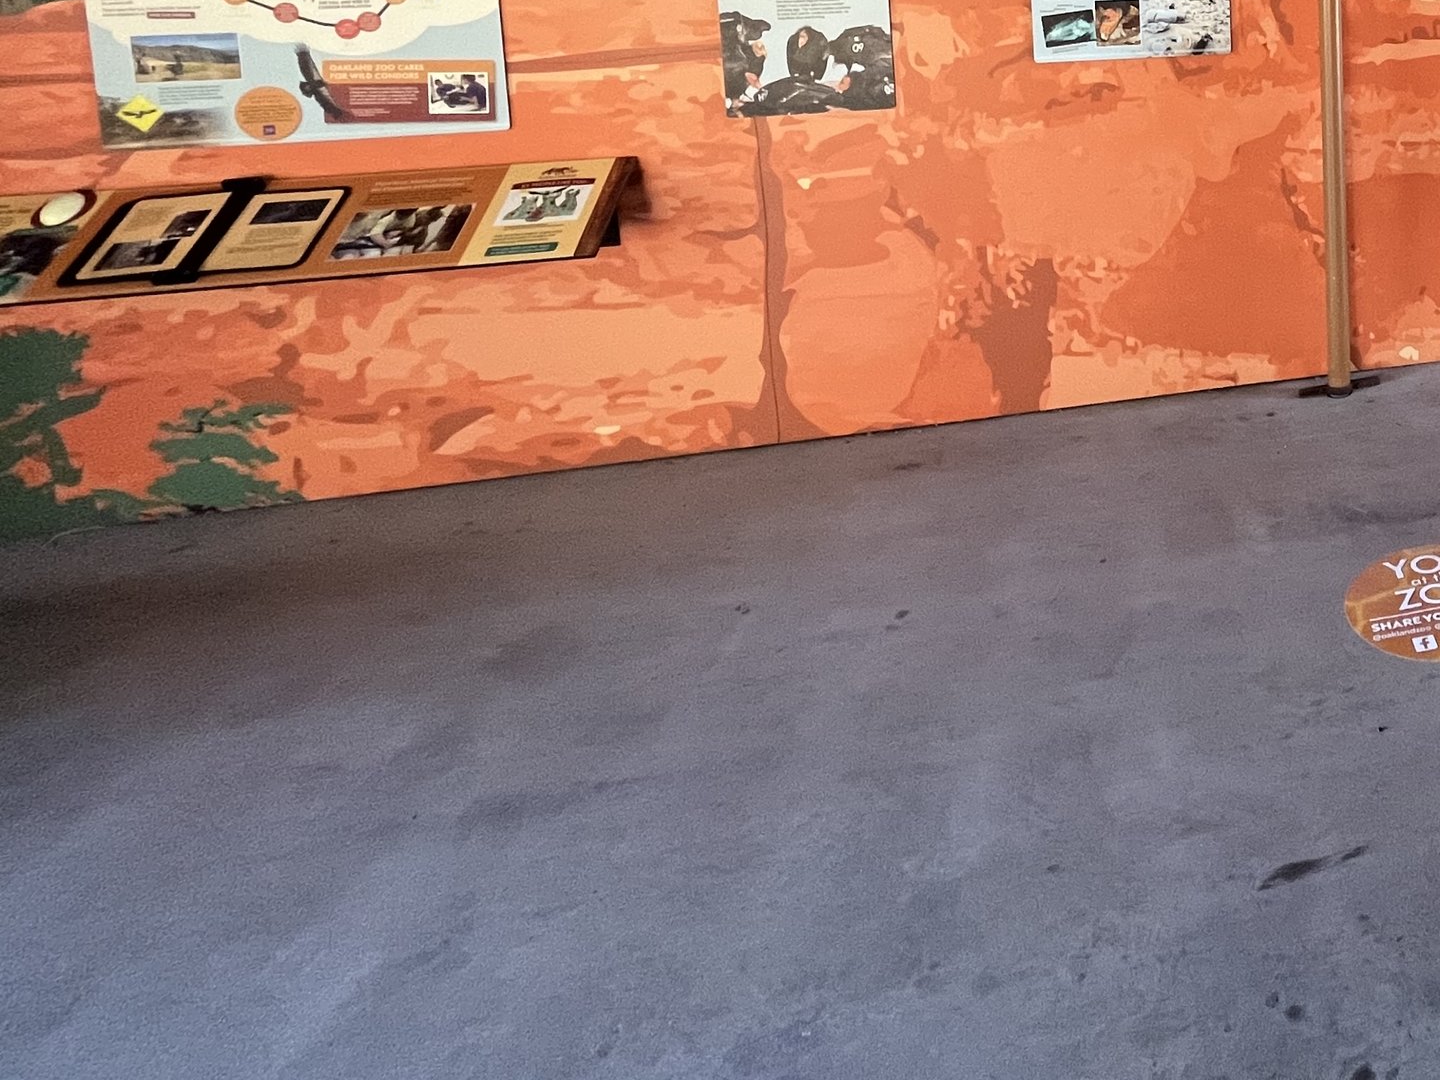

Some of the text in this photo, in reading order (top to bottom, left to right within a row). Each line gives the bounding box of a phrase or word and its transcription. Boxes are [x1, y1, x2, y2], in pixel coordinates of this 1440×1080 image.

[329, 63, 373, 71] OAKLAND
[374, 63, 396, 71] ZOO
[1411, 574, 1428, 587] at
[1371, 616, 1422, 633] SHARE
